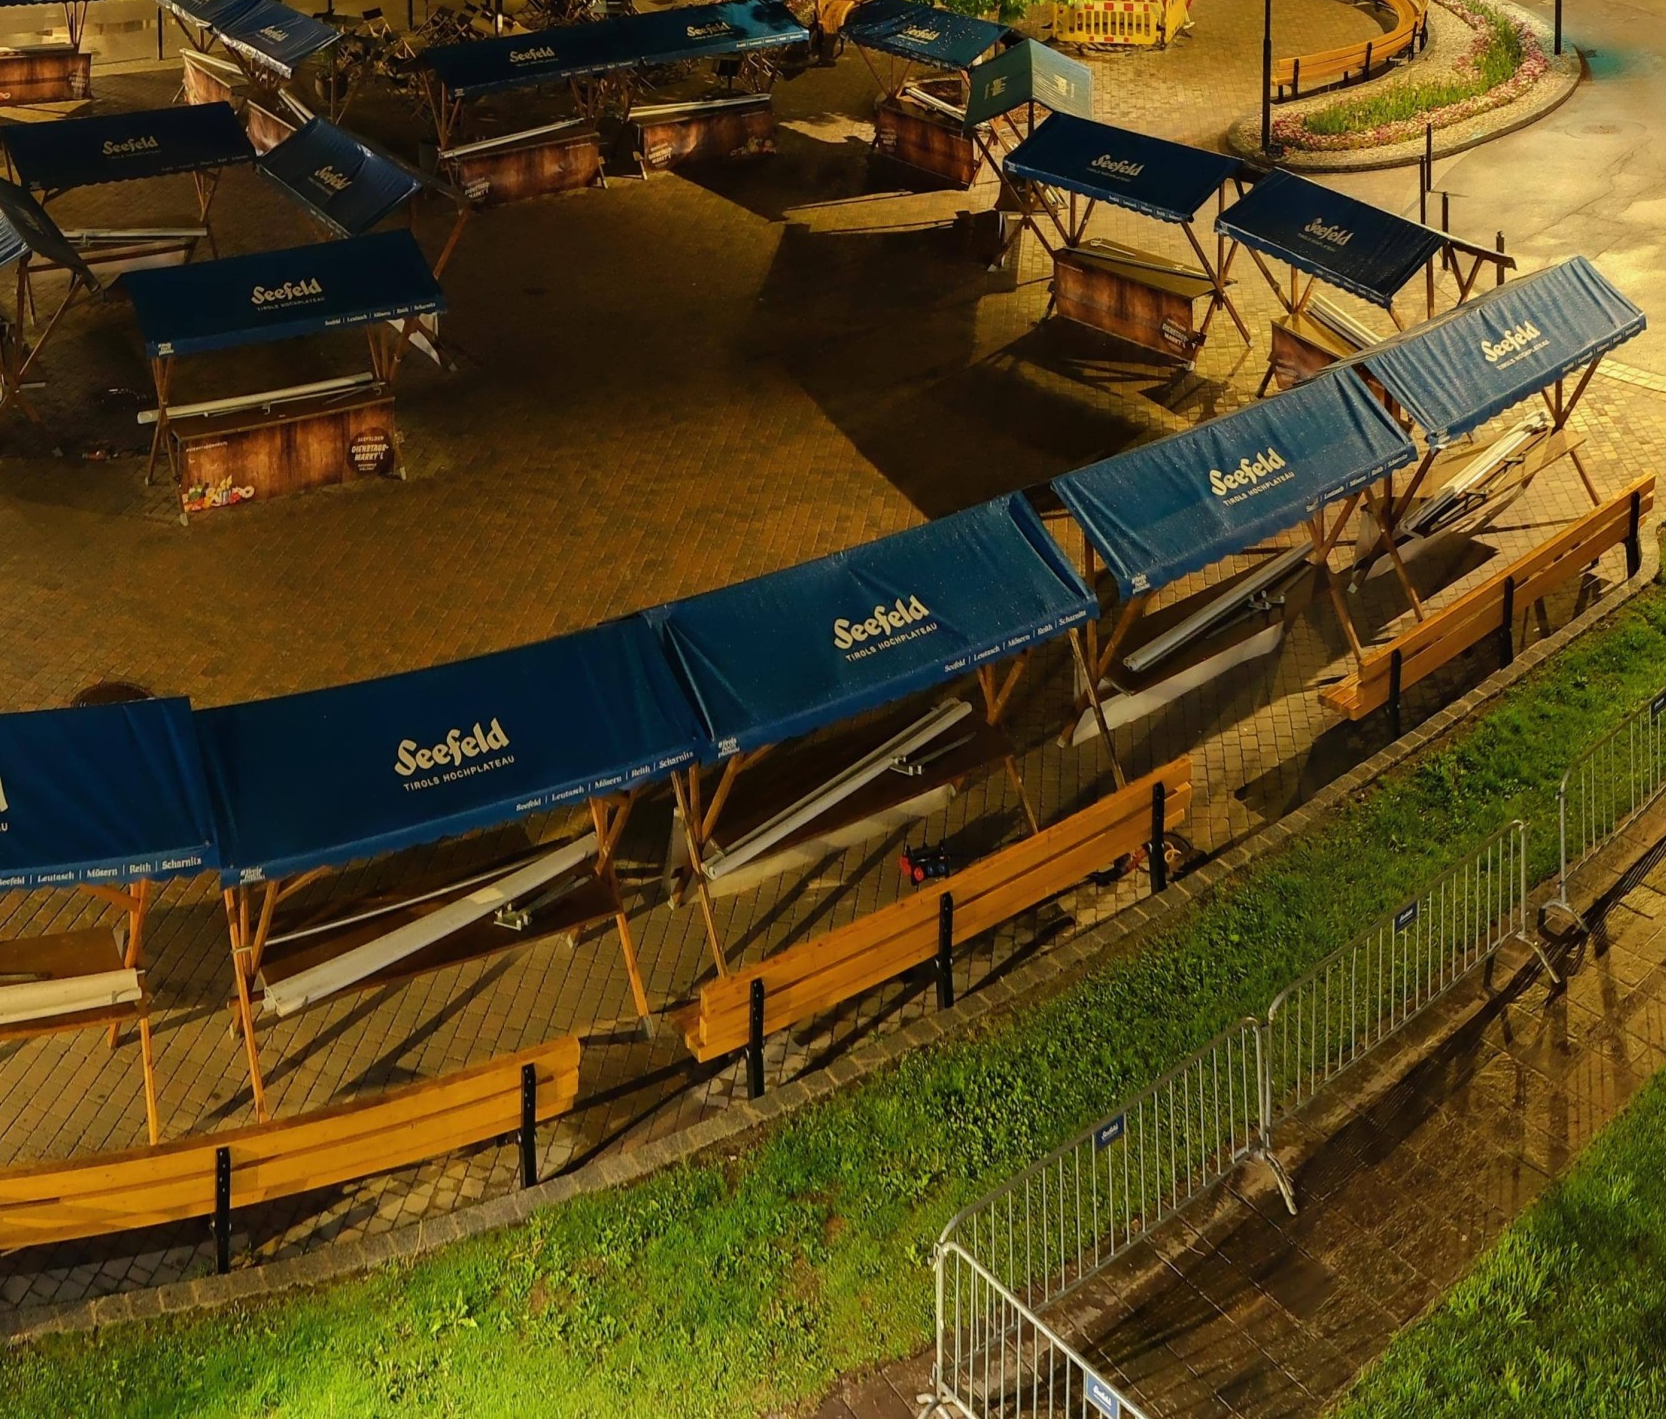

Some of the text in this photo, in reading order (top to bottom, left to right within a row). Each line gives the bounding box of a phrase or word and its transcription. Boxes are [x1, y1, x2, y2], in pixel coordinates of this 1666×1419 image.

[102, 135, 159, 156] Seefeld
[1091, 153, 1144, 179] Seefeld
[1304, 216, 1356, 247] Seefeld
[251, 277, 323, 305] Seefeld
[1481, 319, 1542, 363] Seefeld
[1209, 446, 1287, 497] Seefeld
[833, 594, 930, 651] Seefeld
[844, 622, 938, 663] TIROLS HOCHPLATEAU
[393, 717, 510, 777] Seefeld
[403, 754, 516, 793] TIROLS HOCHPLATEAU
[516, 796, 542, 813] Seefeld
